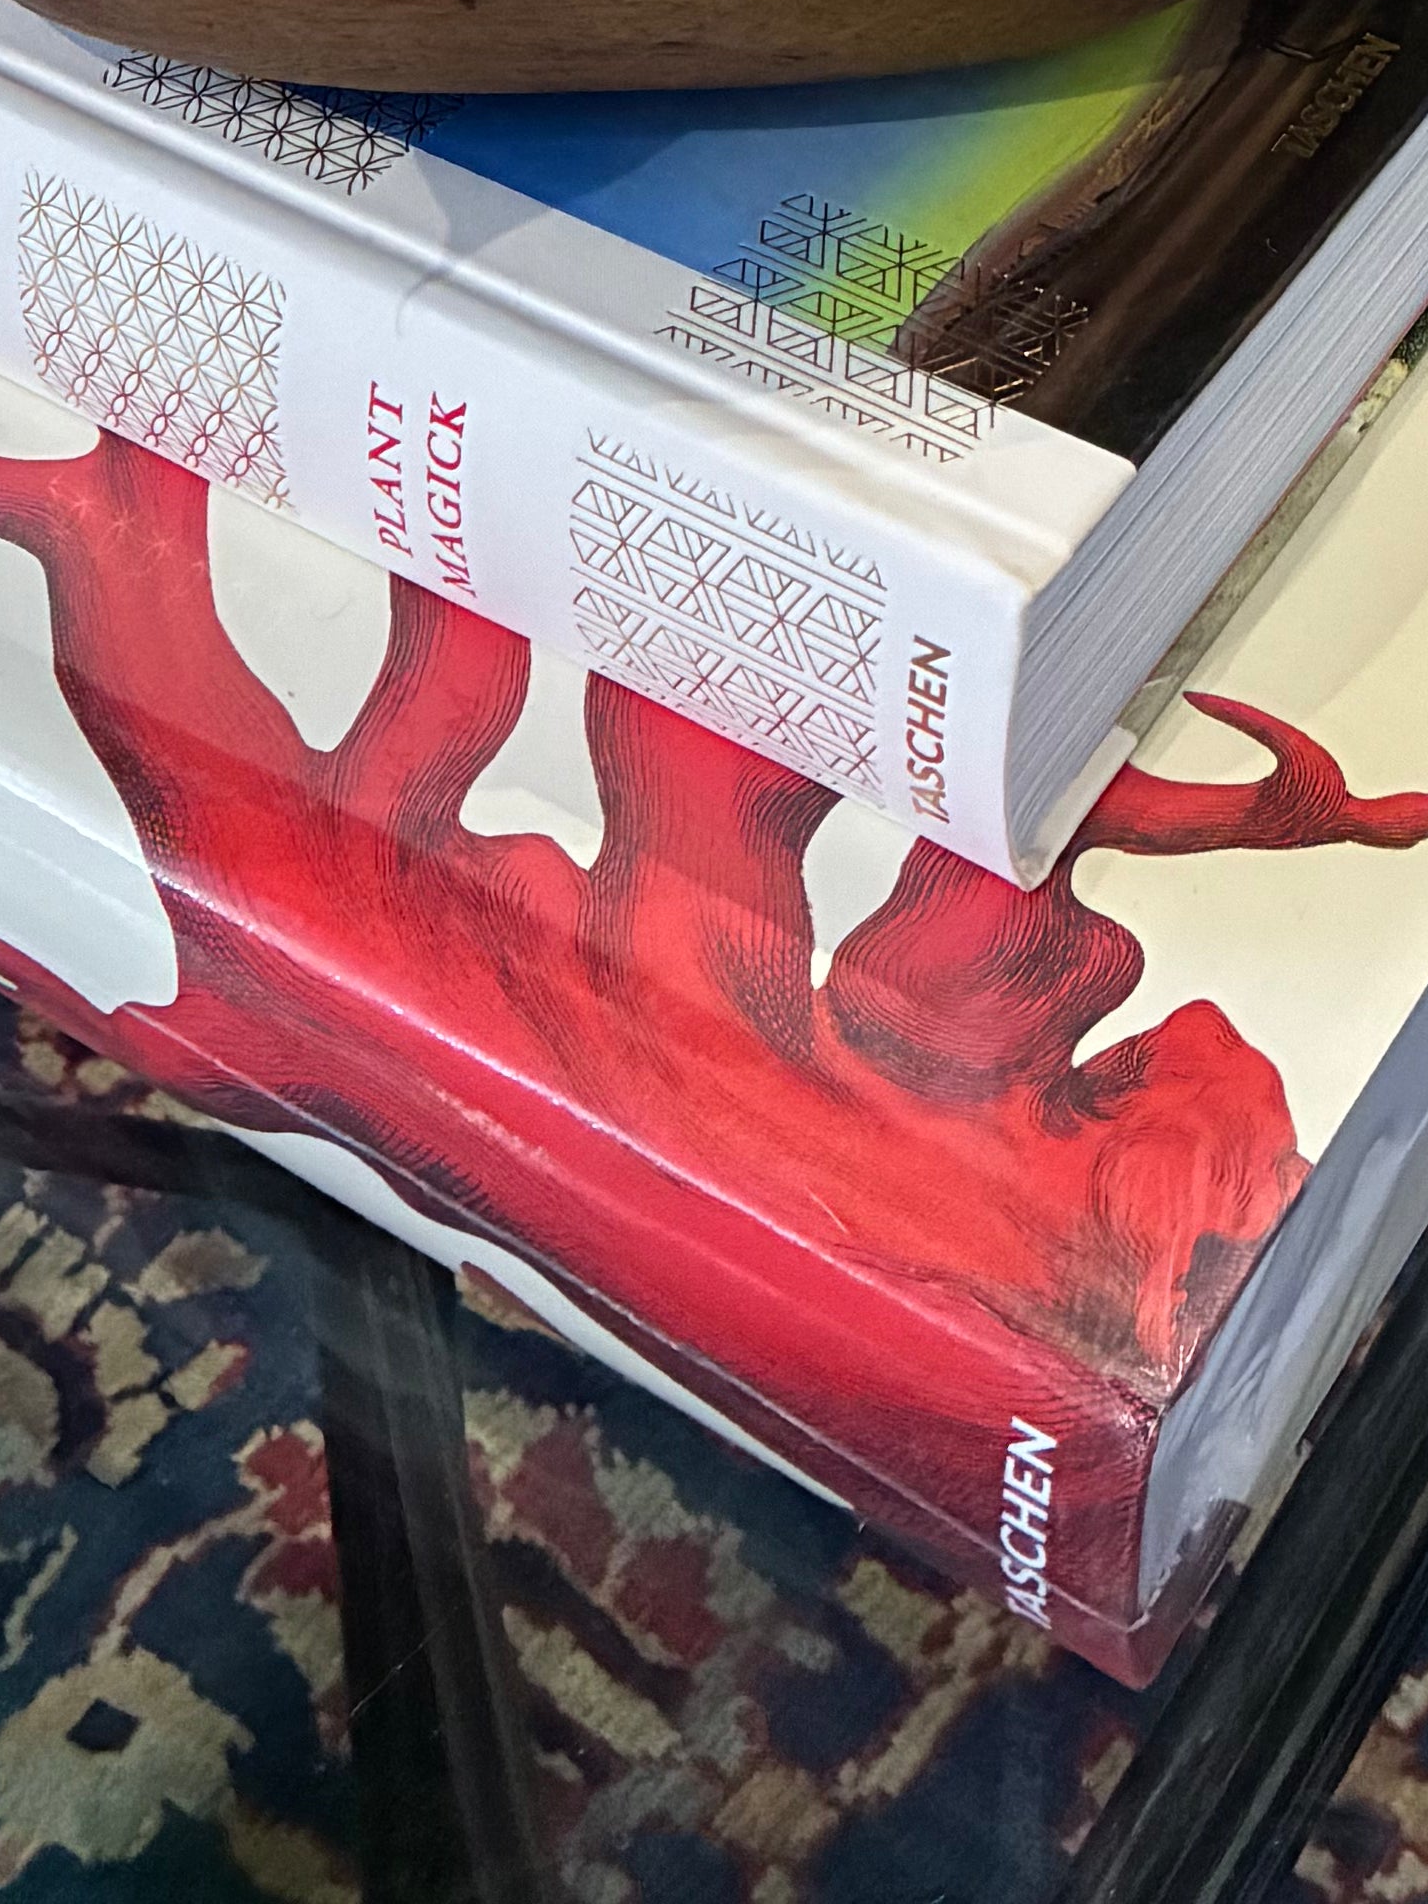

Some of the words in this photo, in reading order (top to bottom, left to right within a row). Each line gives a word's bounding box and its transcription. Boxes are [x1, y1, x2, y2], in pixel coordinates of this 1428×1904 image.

[367, 380, 414, 559] PLANT
[426, 390, 477, 599] MAGICK
[906, 633, 952, 824] TASCHEN
[999, 1414, 1058, 1630] TASCHEN
